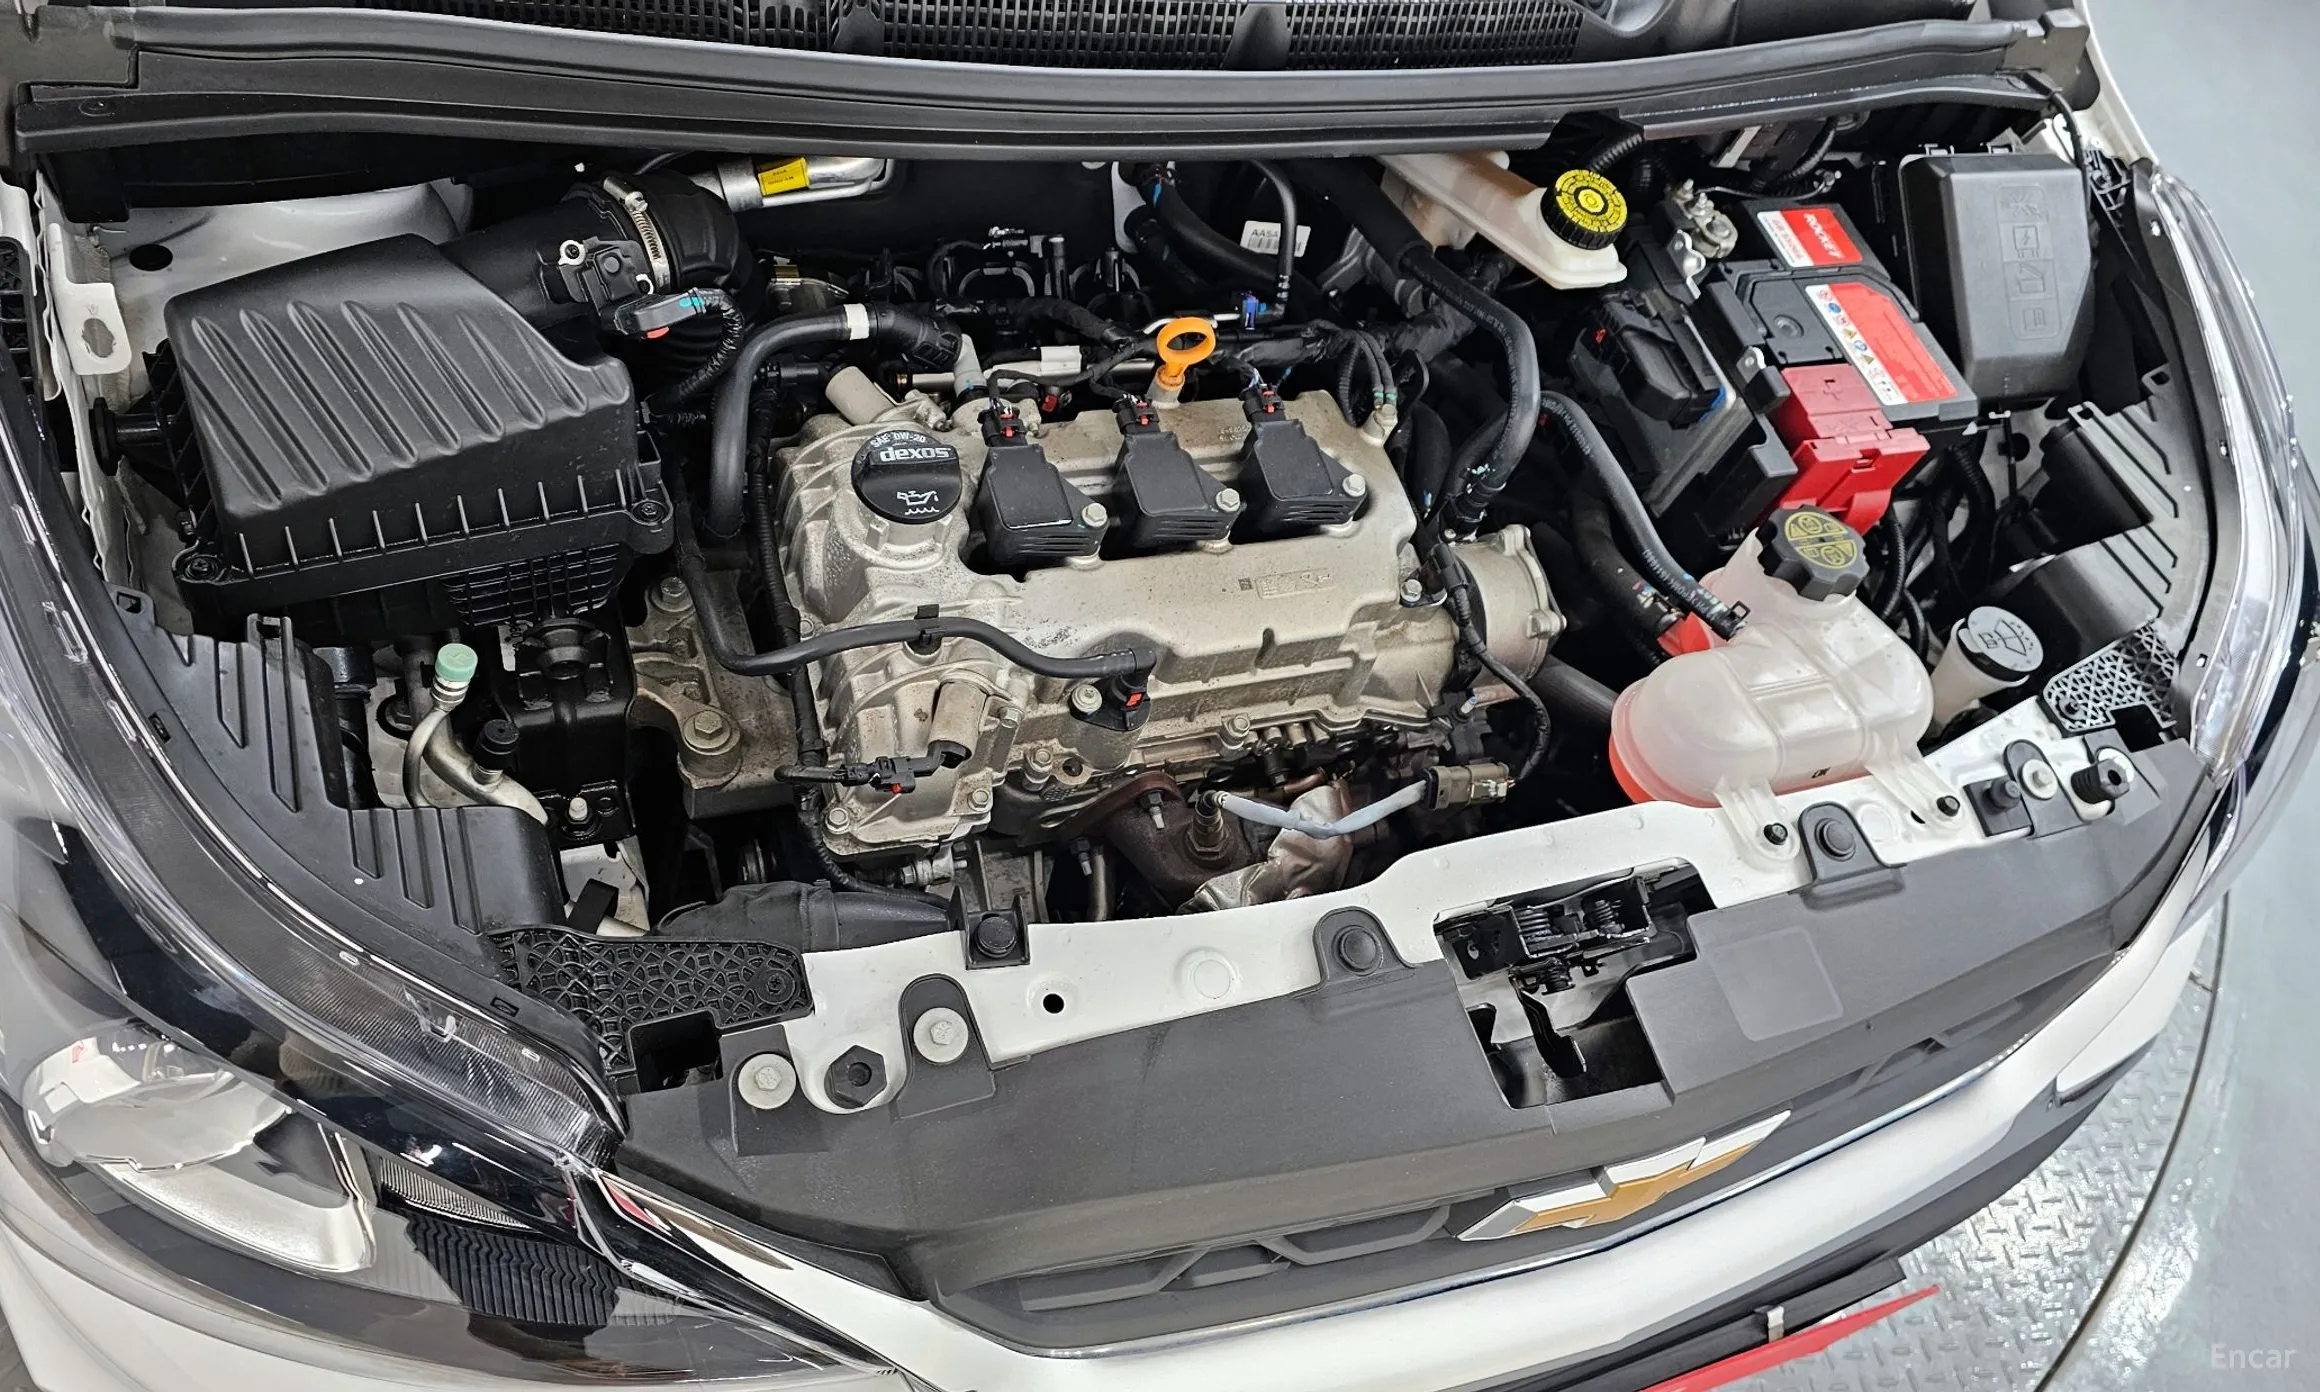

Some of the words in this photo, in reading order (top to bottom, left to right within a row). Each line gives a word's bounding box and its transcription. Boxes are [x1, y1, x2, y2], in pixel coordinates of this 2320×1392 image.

[1803, 212, 1845, 259] ROCKET
[870, 433, 891, 448] SAE
[892, 431, 926, 443] 0W-20
[880, 446, 951, 462] dexos
